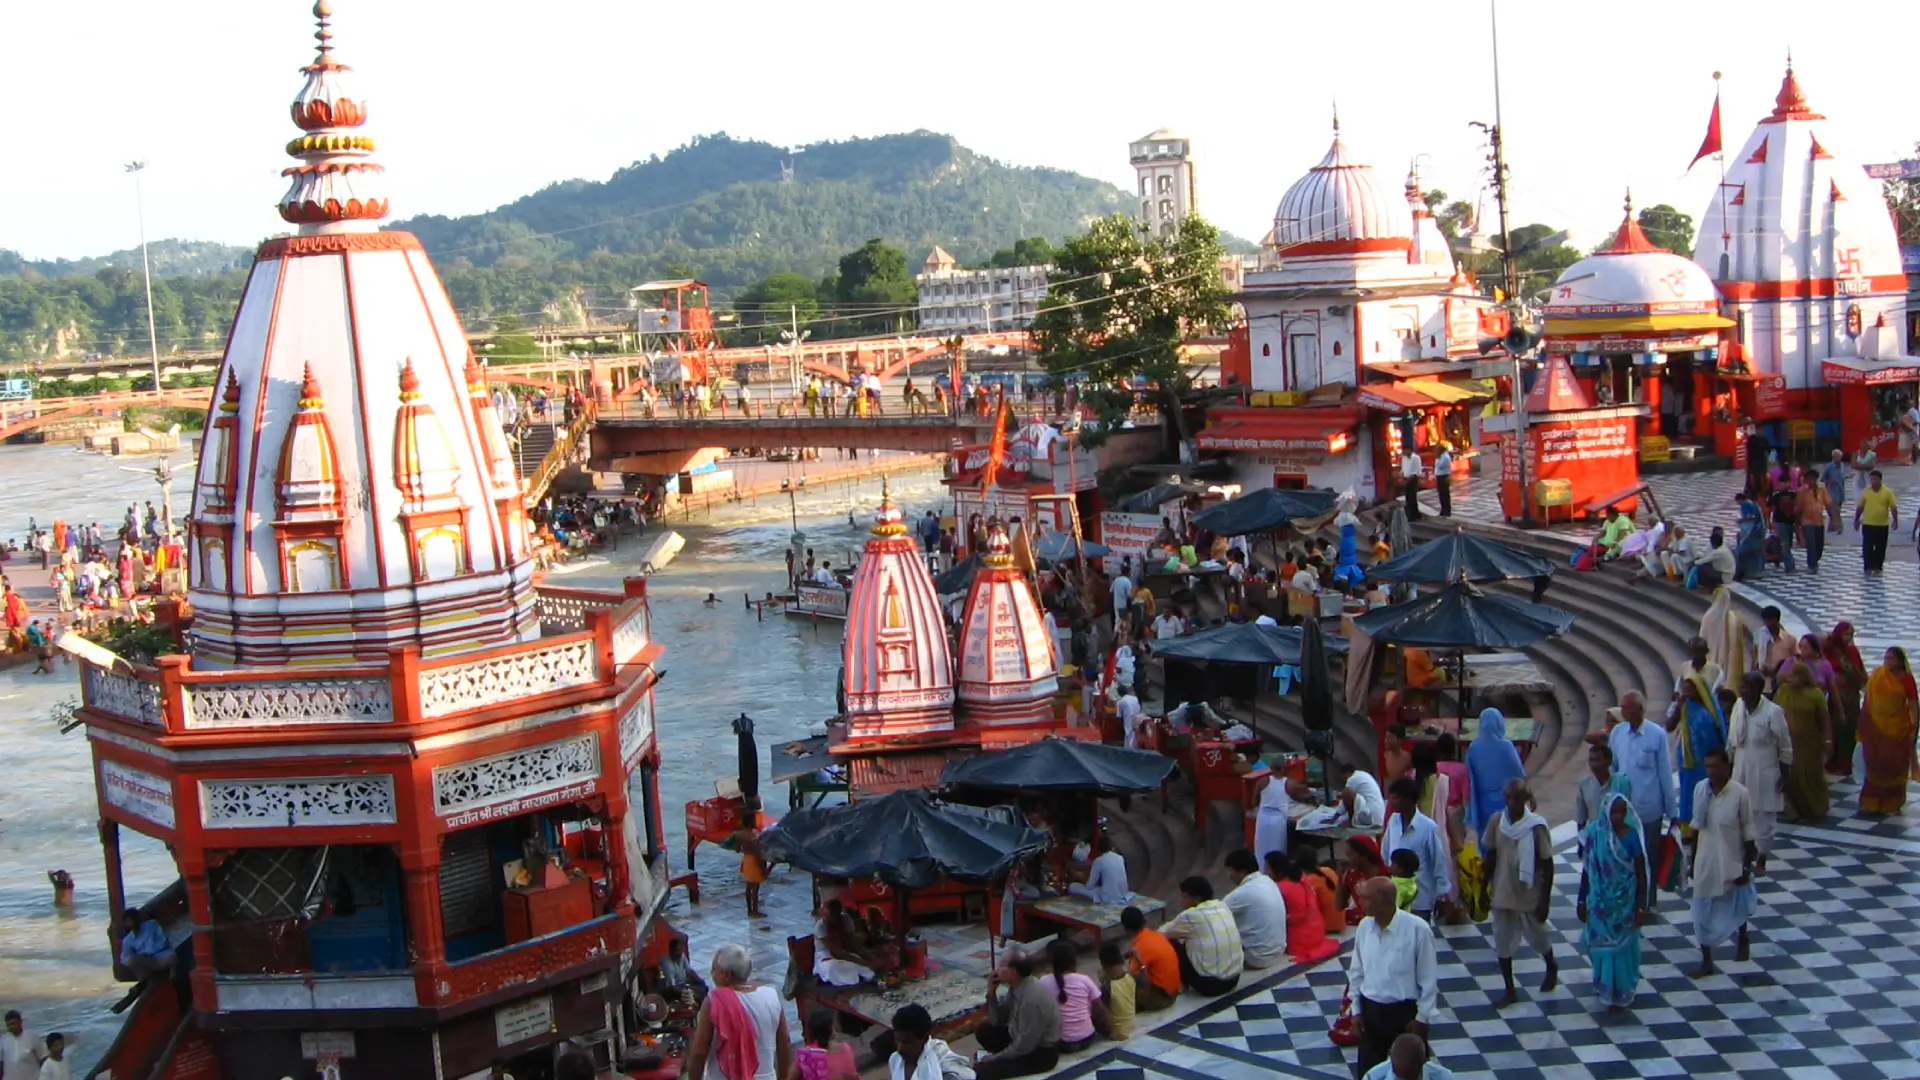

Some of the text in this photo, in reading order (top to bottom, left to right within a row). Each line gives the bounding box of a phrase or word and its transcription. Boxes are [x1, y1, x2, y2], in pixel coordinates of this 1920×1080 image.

[446, 811, 479, 828] प्राचीन
[479, 805, 492, 820] श्री
[492, 802, 520, 817] लक्ष्मी
[521, 793, 559, 810] नारायण
[583, 781, 596, 796] जी
